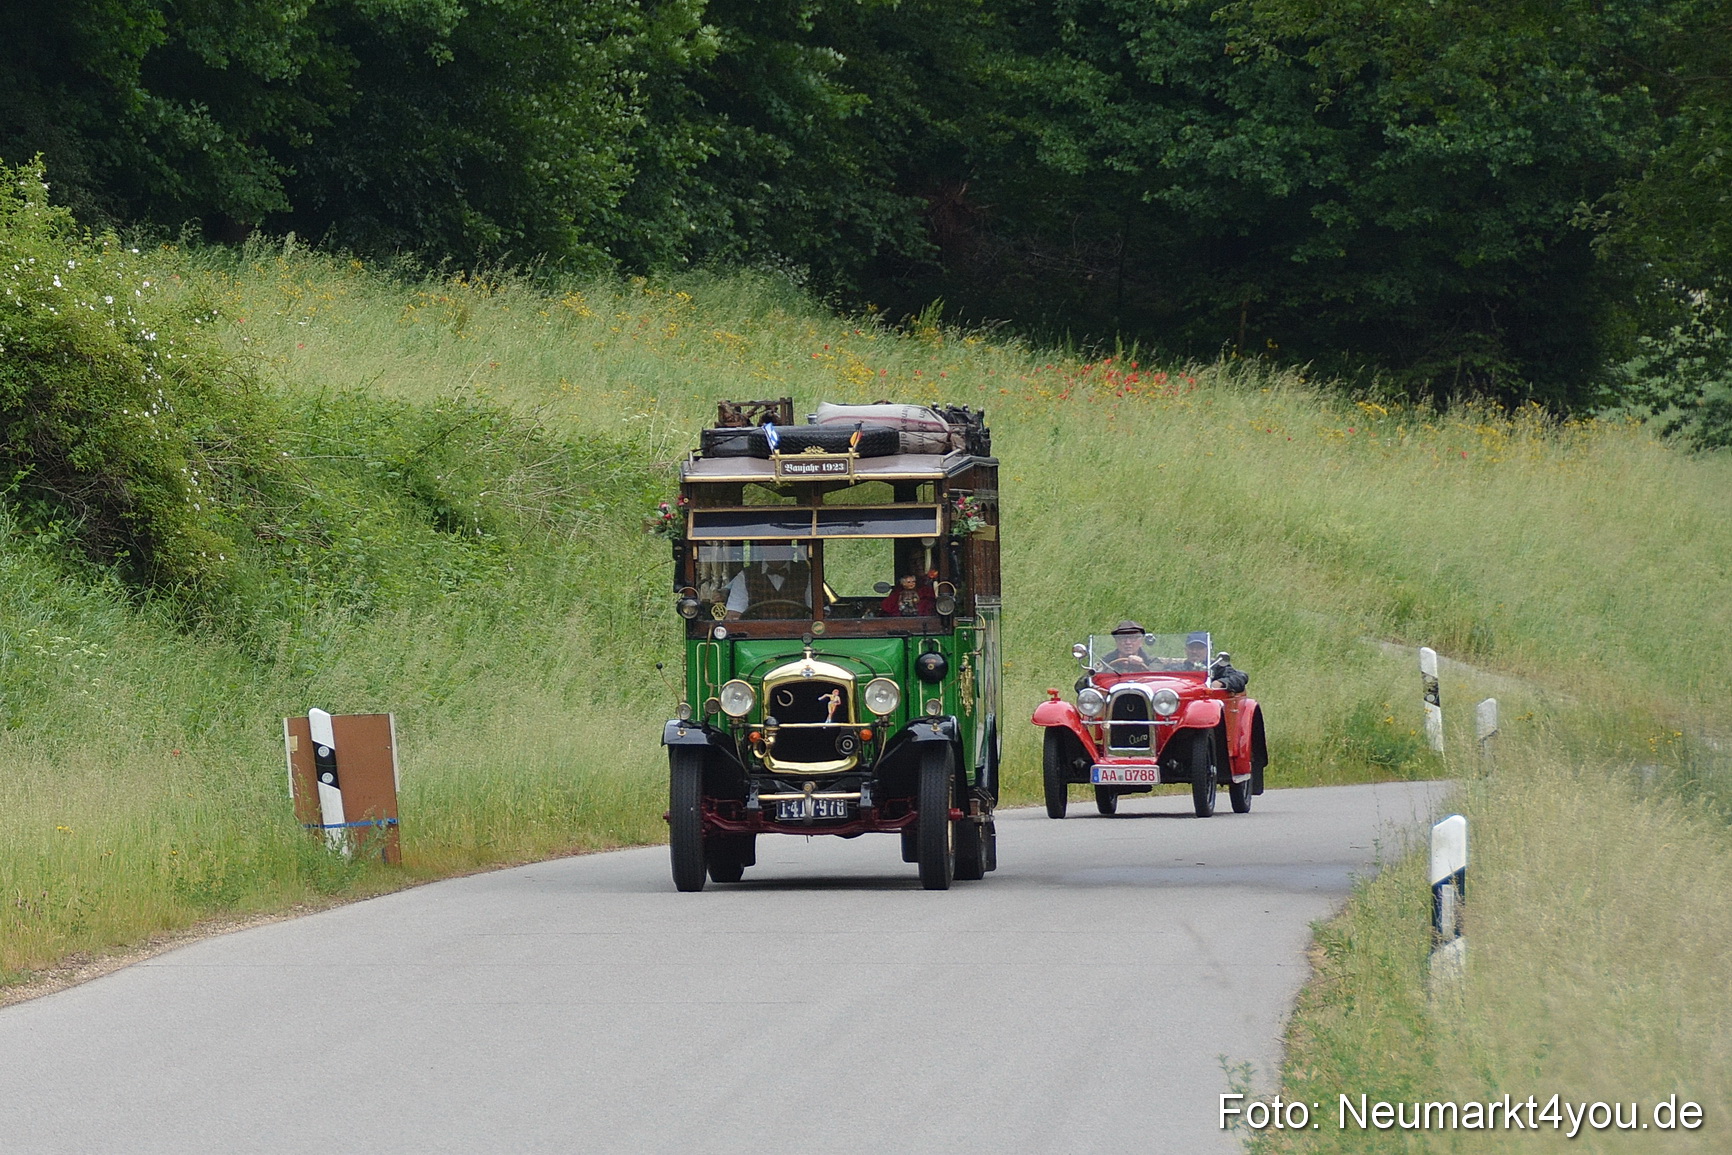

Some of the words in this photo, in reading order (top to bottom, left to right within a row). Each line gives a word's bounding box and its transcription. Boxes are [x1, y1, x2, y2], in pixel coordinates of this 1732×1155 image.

[784, 462, 820, 474] Baujahr
[822, 462, 844, 472] 1923
[1101, 770, 1117, 781] AA
[1124, 769, 1155, 781] 0788
